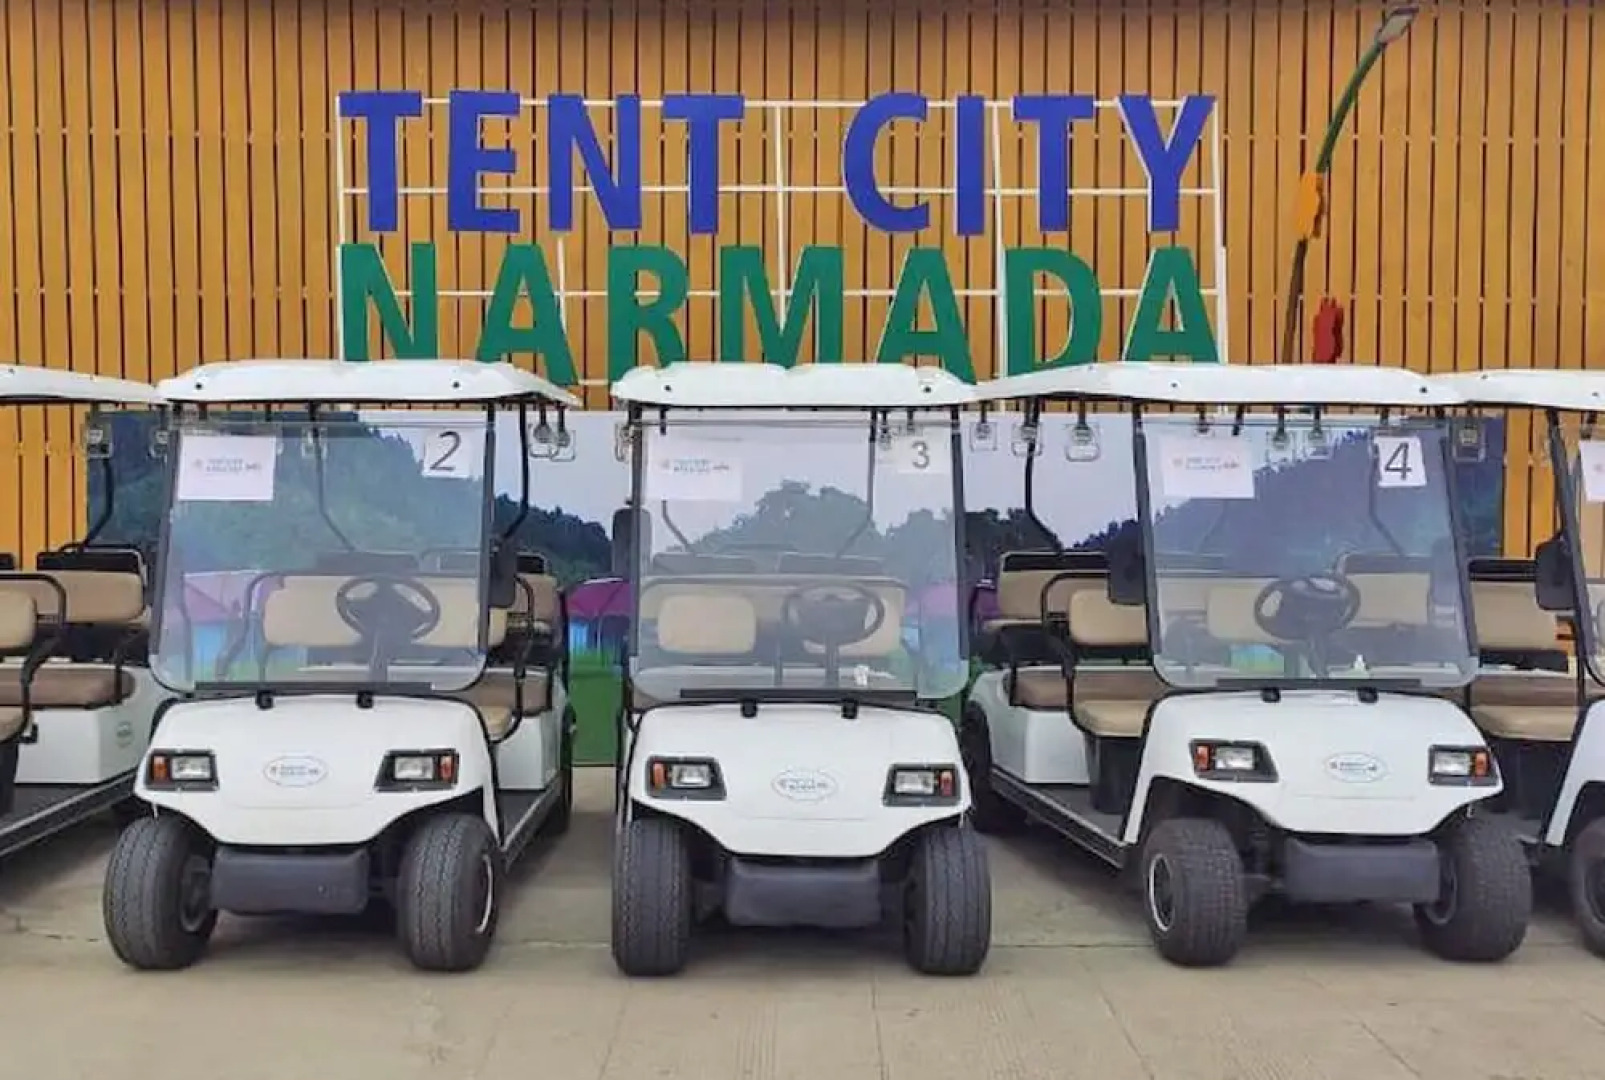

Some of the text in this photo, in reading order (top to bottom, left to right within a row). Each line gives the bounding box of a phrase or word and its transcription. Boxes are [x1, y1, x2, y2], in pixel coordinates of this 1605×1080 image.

[339, 90, 1217, 237] TENT CITY
[338, 243, 1219, 386] NARMADA
[430, 430, 462, 471] 2
[911, 440, 931, 470] 3
[1384, 441, 1413, 480] 4
